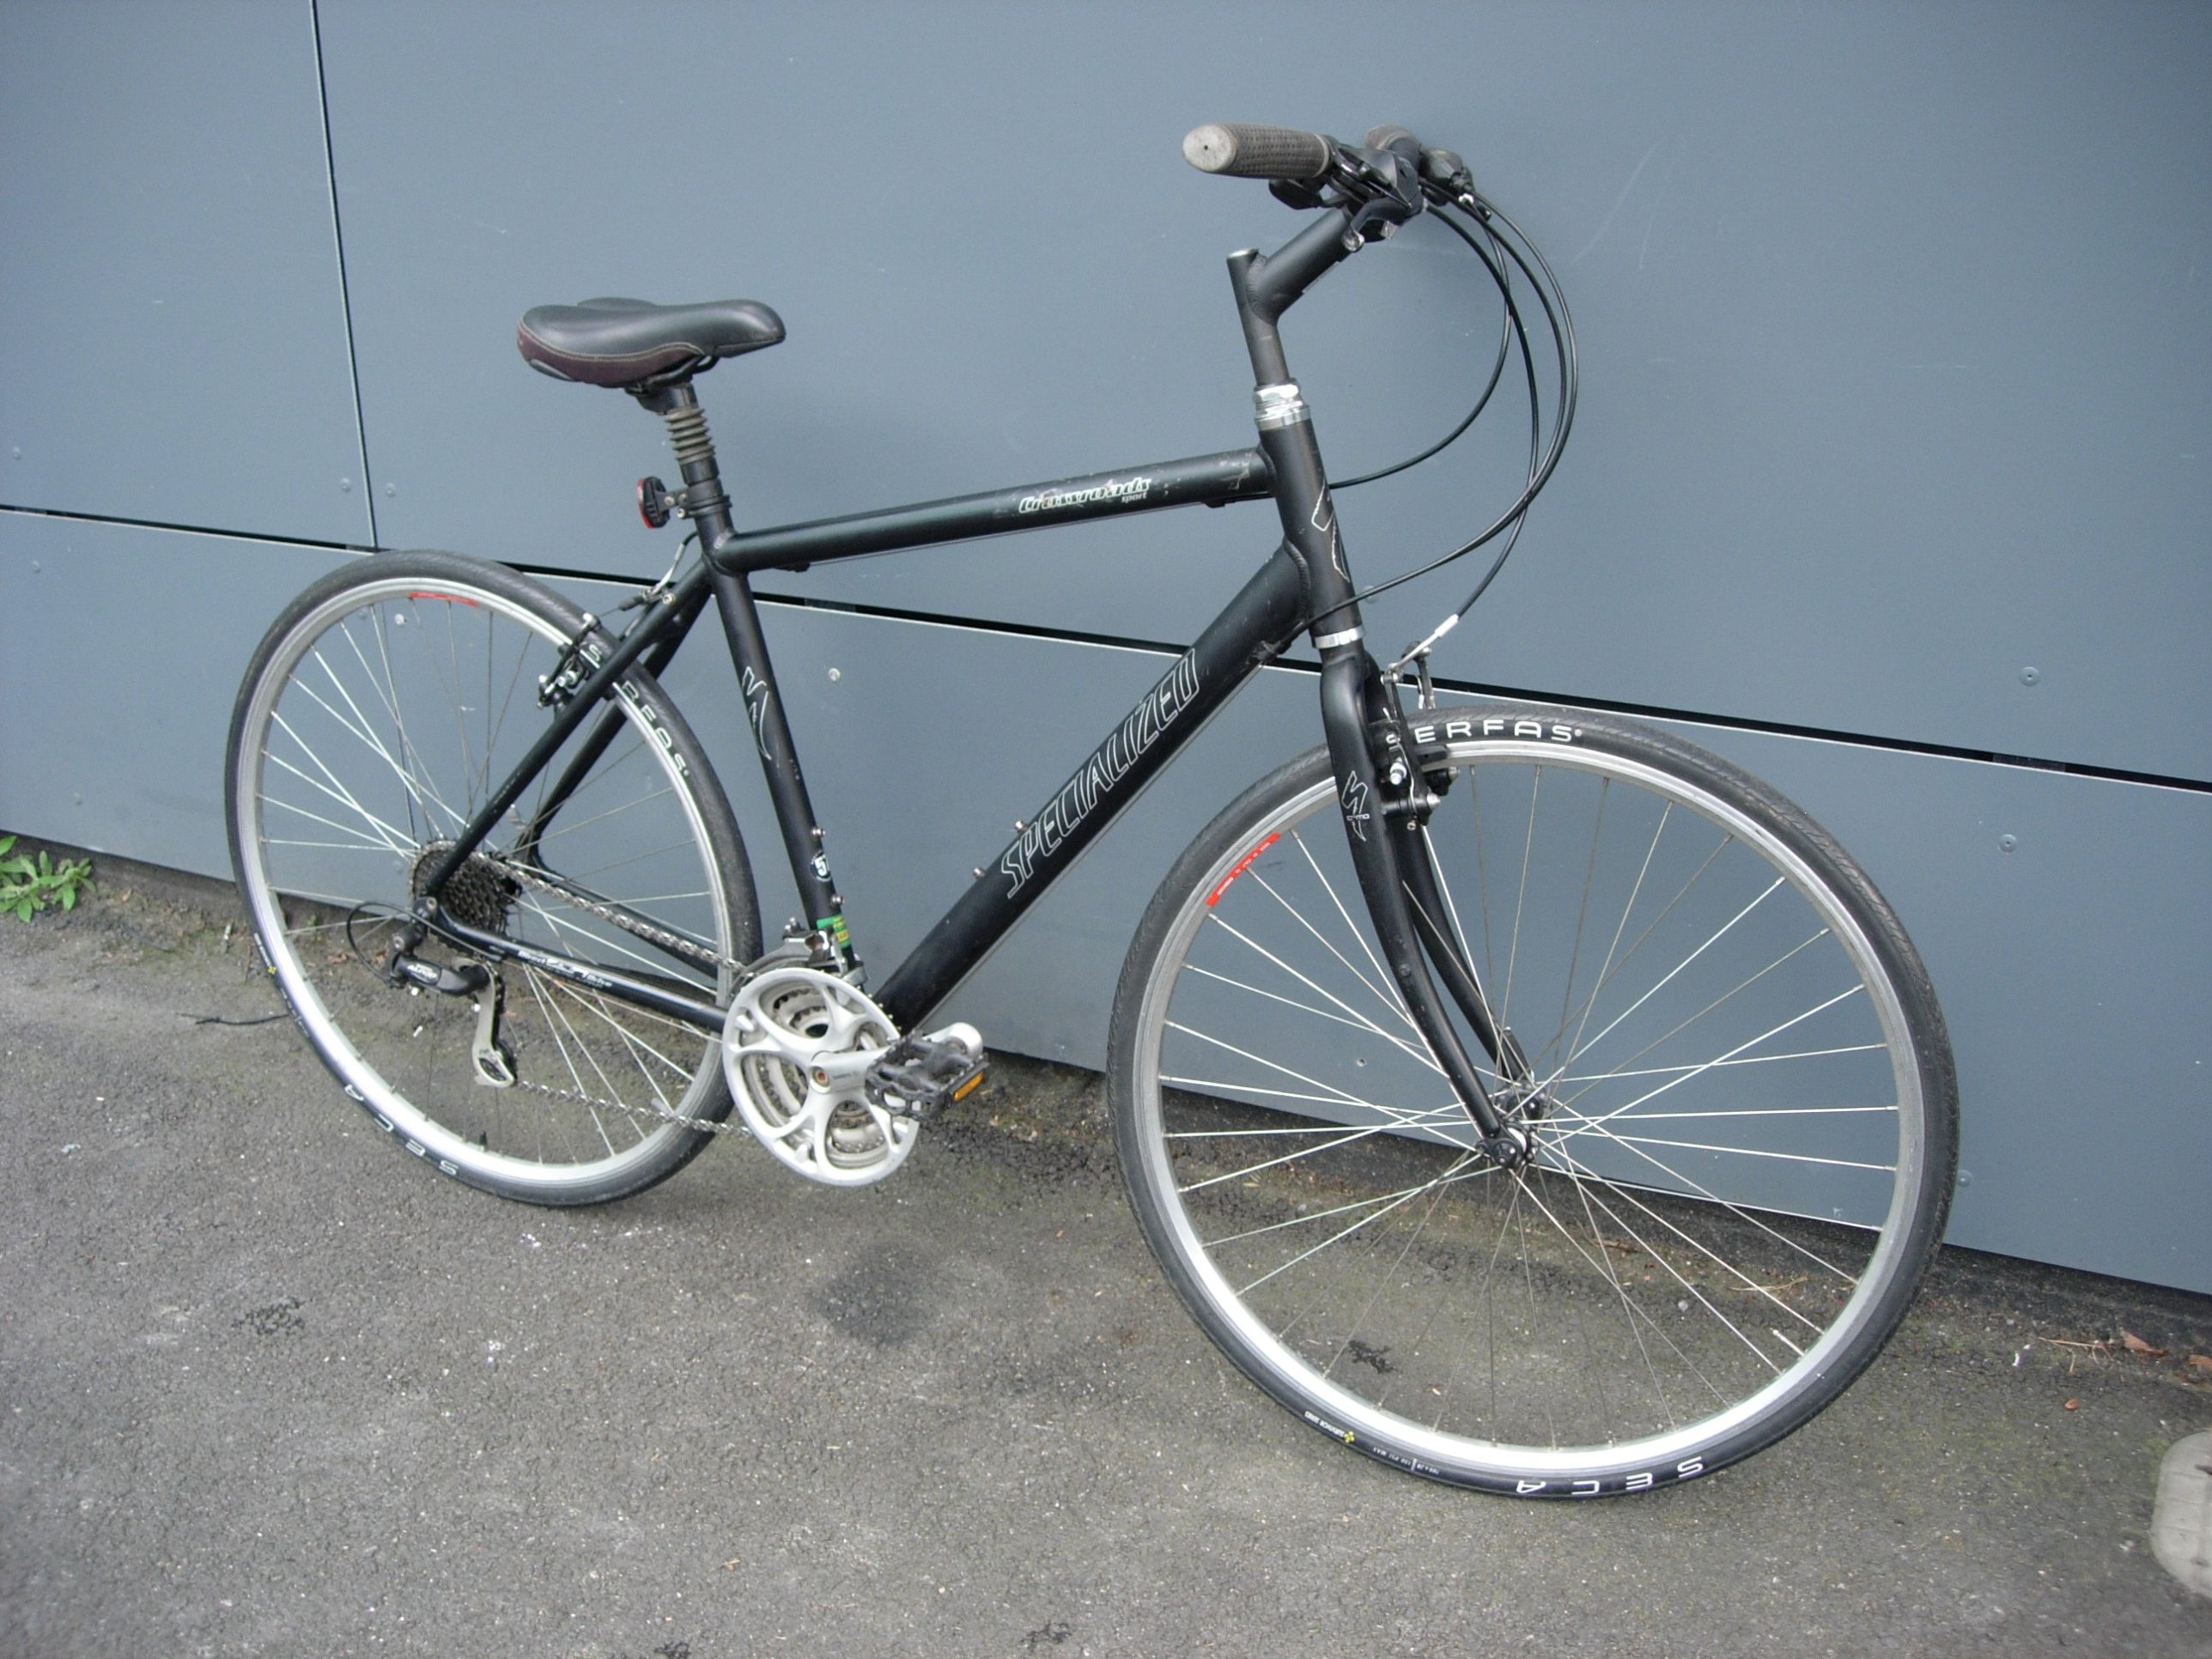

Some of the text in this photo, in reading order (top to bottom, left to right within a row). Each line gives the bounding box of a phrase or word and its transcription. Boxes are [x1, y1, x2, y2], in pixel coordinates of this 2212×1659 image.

[1121, 491, 1147, 503] sport
[1001, 648, 1200, 899] SPECIALIZED
[345, 1084, 459, 1176] SECA
[1516, 1456, 1704, 1495] SECA
